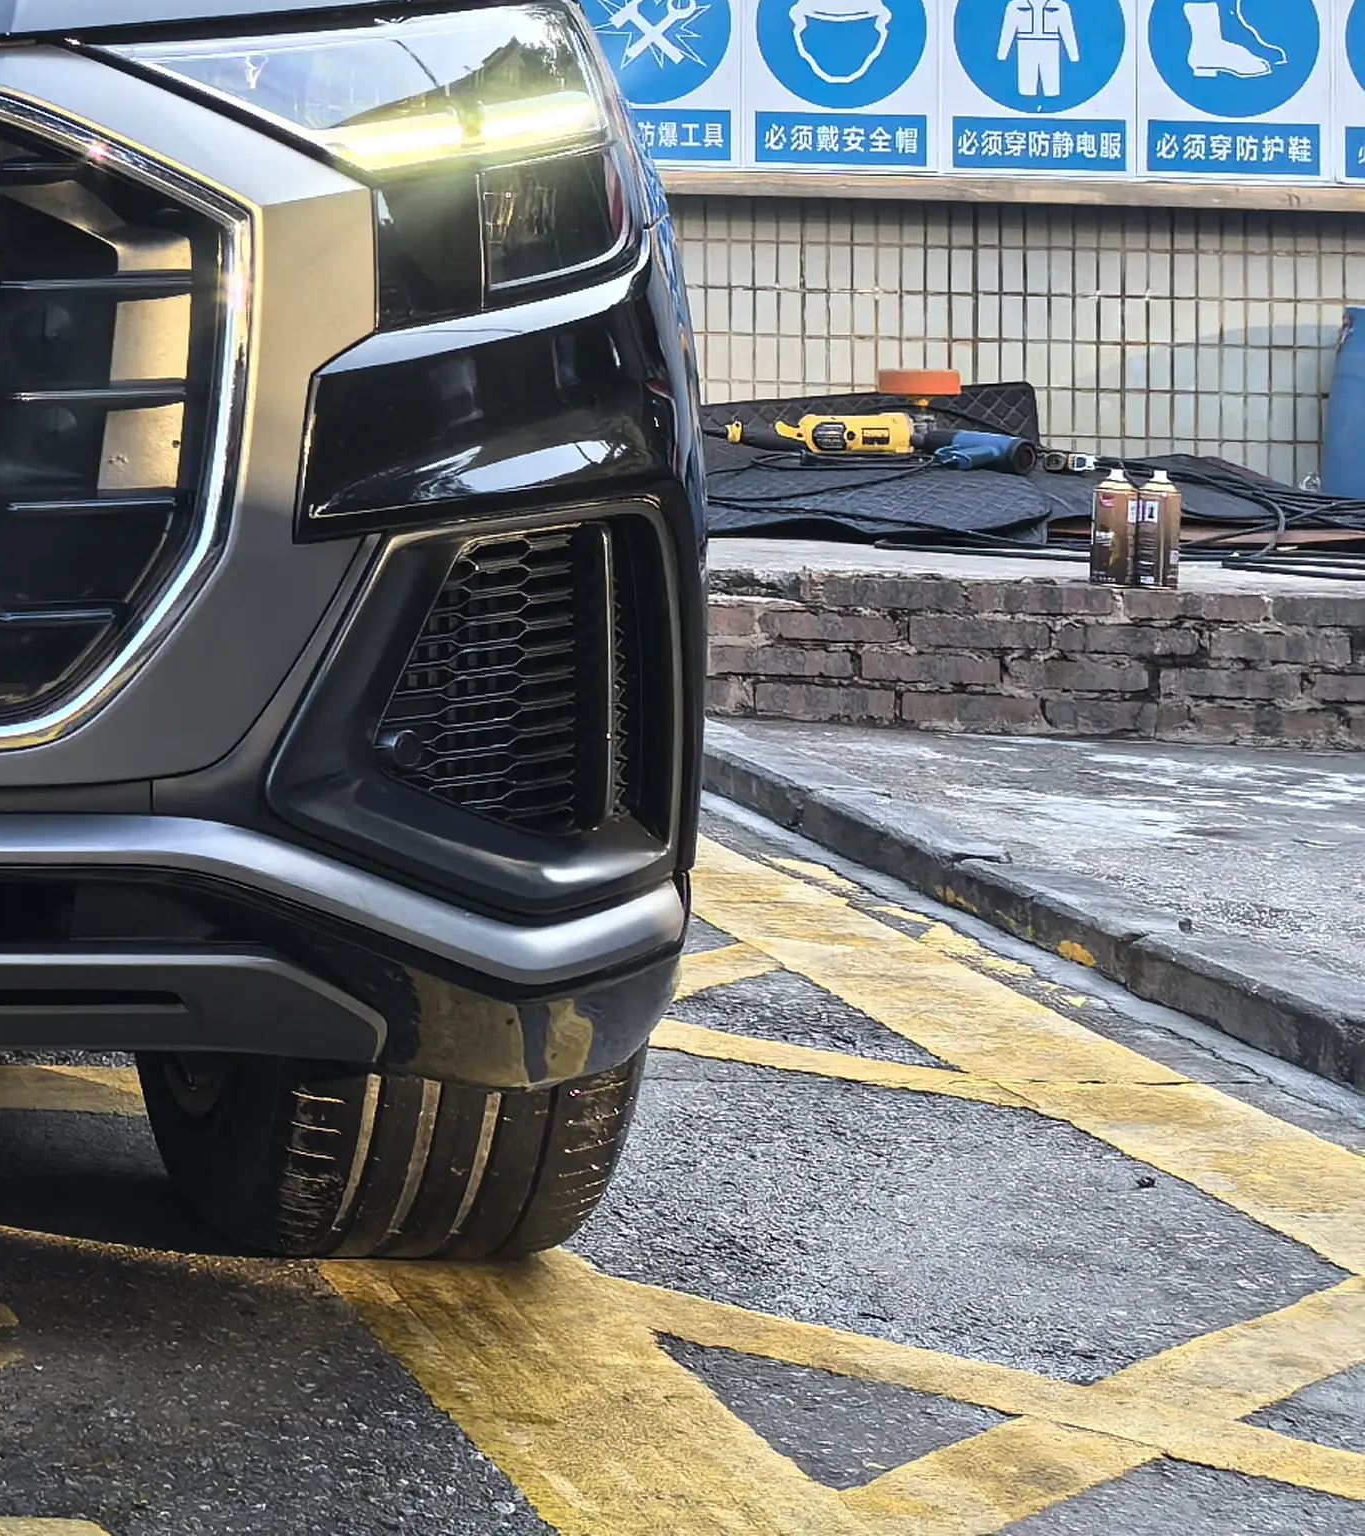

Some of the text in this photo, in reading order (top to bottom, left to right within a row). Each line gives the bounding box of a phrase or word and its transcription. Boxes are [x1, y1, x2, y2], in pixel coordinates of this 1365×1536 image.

[764, 124, 920, 155] 必须戴安全帽
[957, 128, 1123, 160] 必须穿防静电服
[1155, 132, 1313, 163] 必须穿防护鞋
